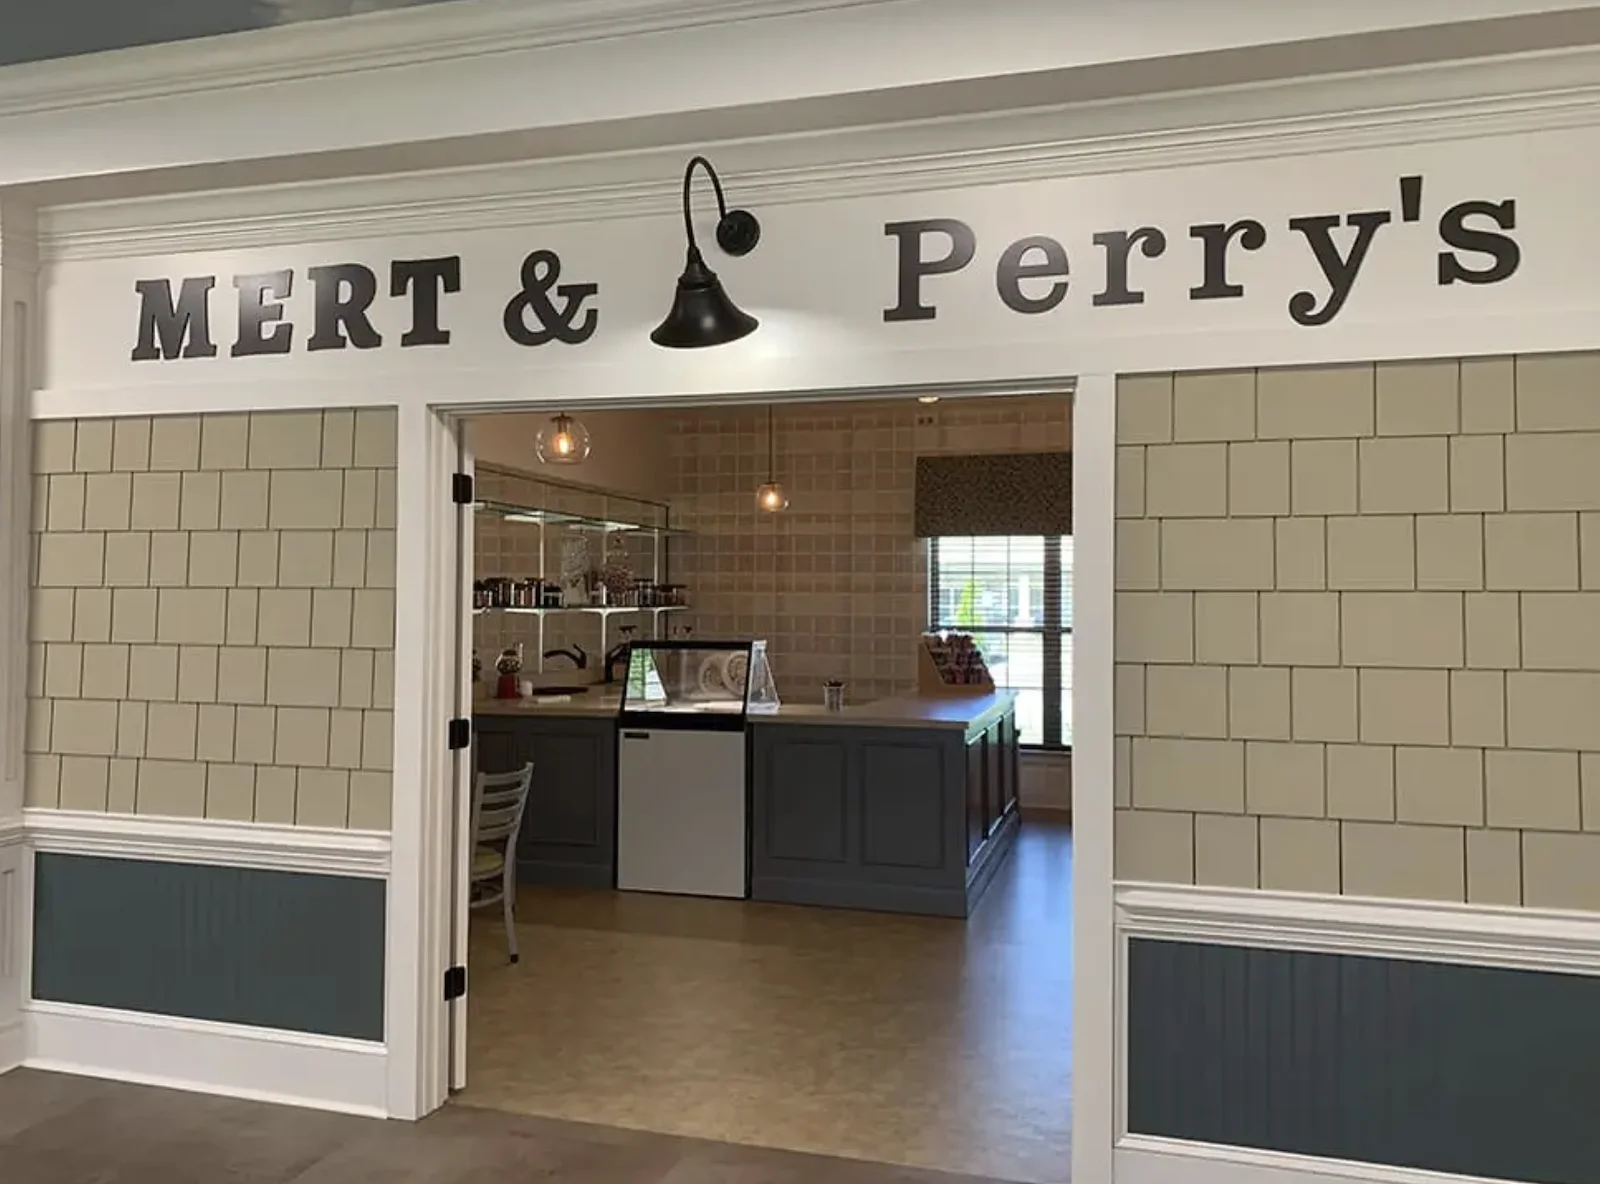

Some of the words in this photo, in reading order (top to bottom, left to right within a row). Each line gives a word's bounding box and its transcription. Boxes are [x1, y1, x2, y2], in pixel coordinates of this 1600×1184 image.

[131, 256, 461, 361] MERT
[503, 249, 599, 346] &
[883, 175, 1521, 326] Perry's
